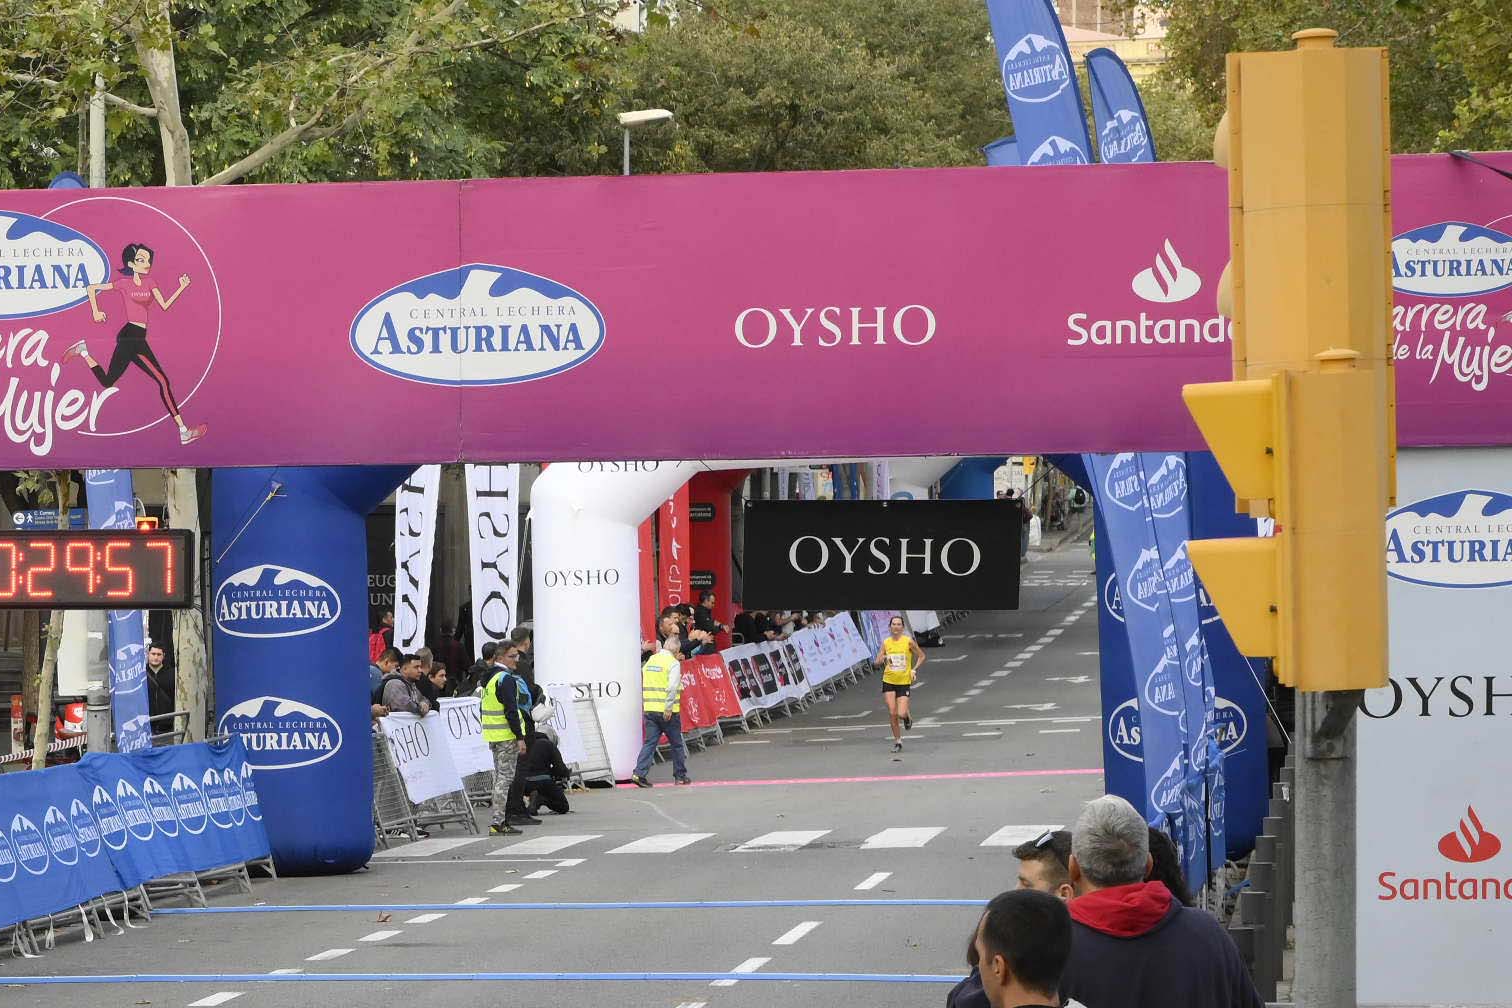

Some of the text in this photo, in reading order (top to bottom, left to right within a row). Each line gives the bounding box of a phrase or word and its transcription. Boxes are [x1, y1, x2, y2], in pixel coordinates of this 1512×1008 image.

[12, 247, 85, 259] LECHERA
[1407, 248, 1457, 257] CENTRAL
[409, 306, 577, 320] CENTRAL LECHERA
[734, 304, 937, 349] OYSHO
[1392, 302, 1487, 332] arrera
[372, 310, 585, 355] ASTURIANA
[1066, 311, 1233, 346] Santand
[1415, 333, 1434, 360] la
[1429, 327, 1512, 392] Muje
[1413, 525, 1480, 535] CENTRAL
[789, 535, 981, 576] OYSHO
[1386, 527, 1512, 565] ASTURI
[543, 568, 619, 588] OYSHO
[231, 589, 327, 598] CENTRAL LECHERA
[219, 594, 332, 622] ASTURIANA
[574, 680, 622, 700] SHO
[1359, 676, 1512, 719] OYSH
[233, 721, 328, 730] CENTRAL LECHERA
[240, 731, 332, 751] TURIANA
[1378, 872, 1512, 901] Santan
